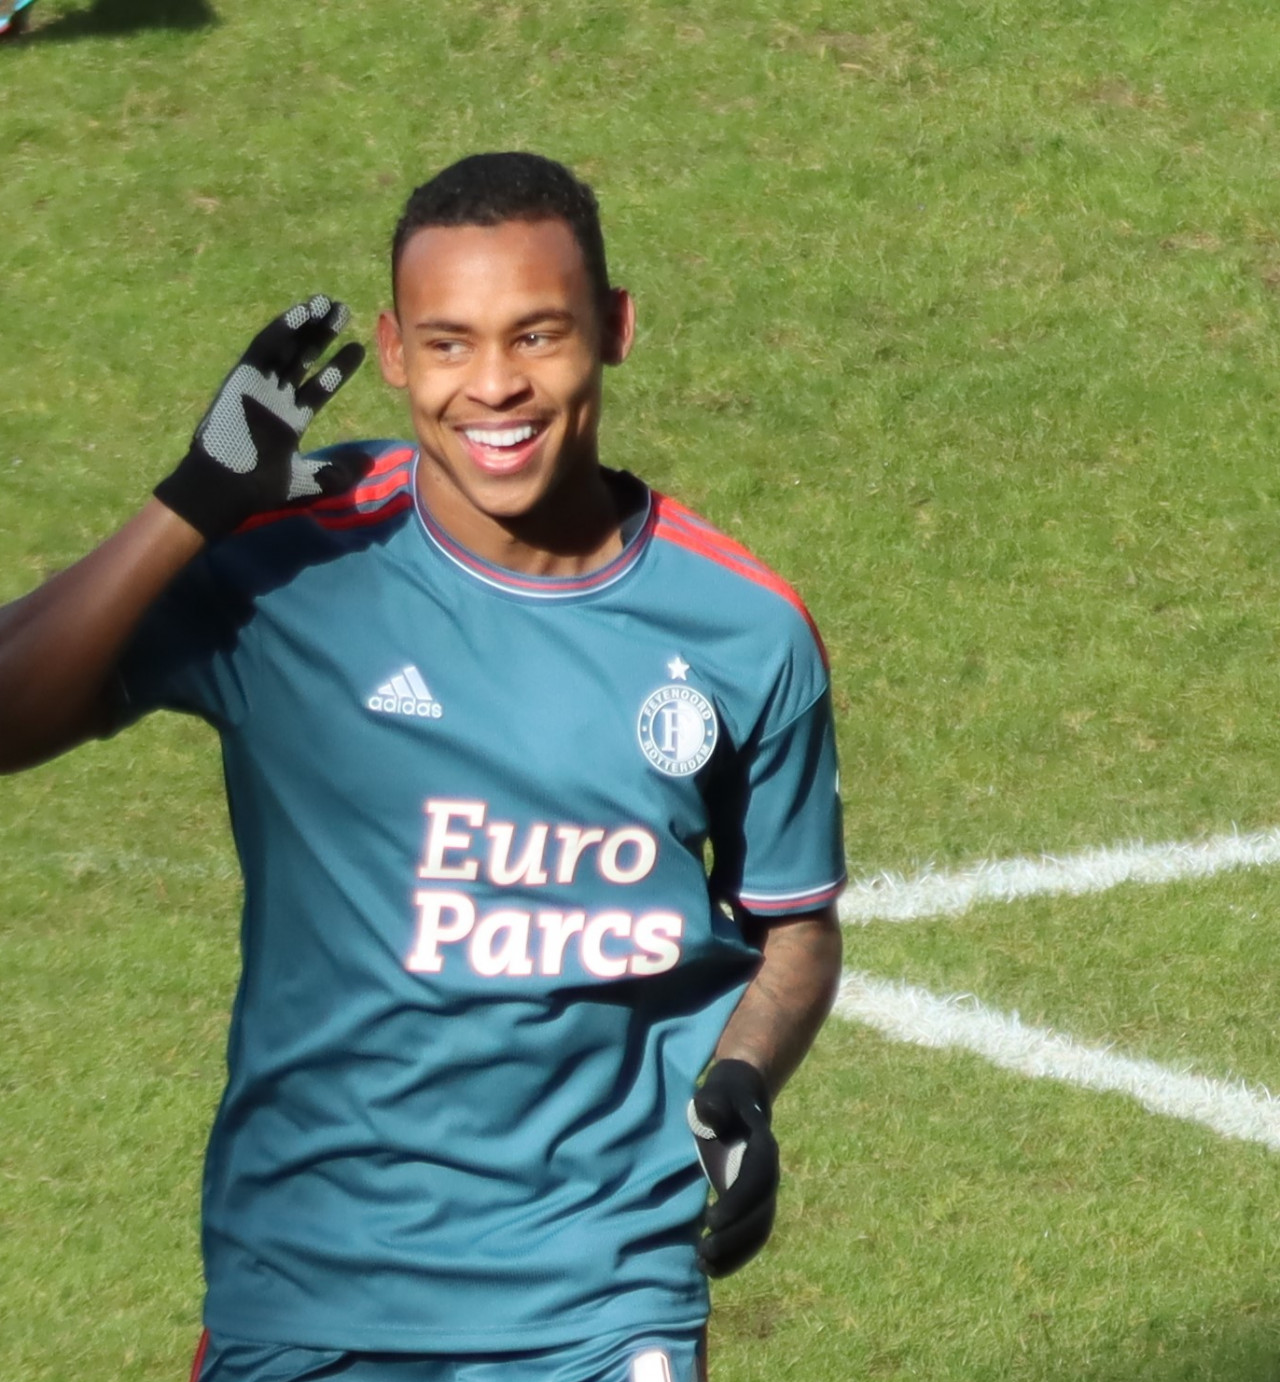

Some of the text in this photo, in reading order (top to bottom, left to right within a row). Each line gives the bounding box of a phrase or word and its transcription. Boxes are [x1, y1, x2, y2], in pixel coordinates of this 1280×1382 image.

[368, 696, 442, 718] adidas
[644, 688, 712, 721] FEYENOORD
[644, 740, 711, 773] ROTTERDAM
[418, 800, 657, 885] Euro
[406, 890, 684, 977] Parcs
